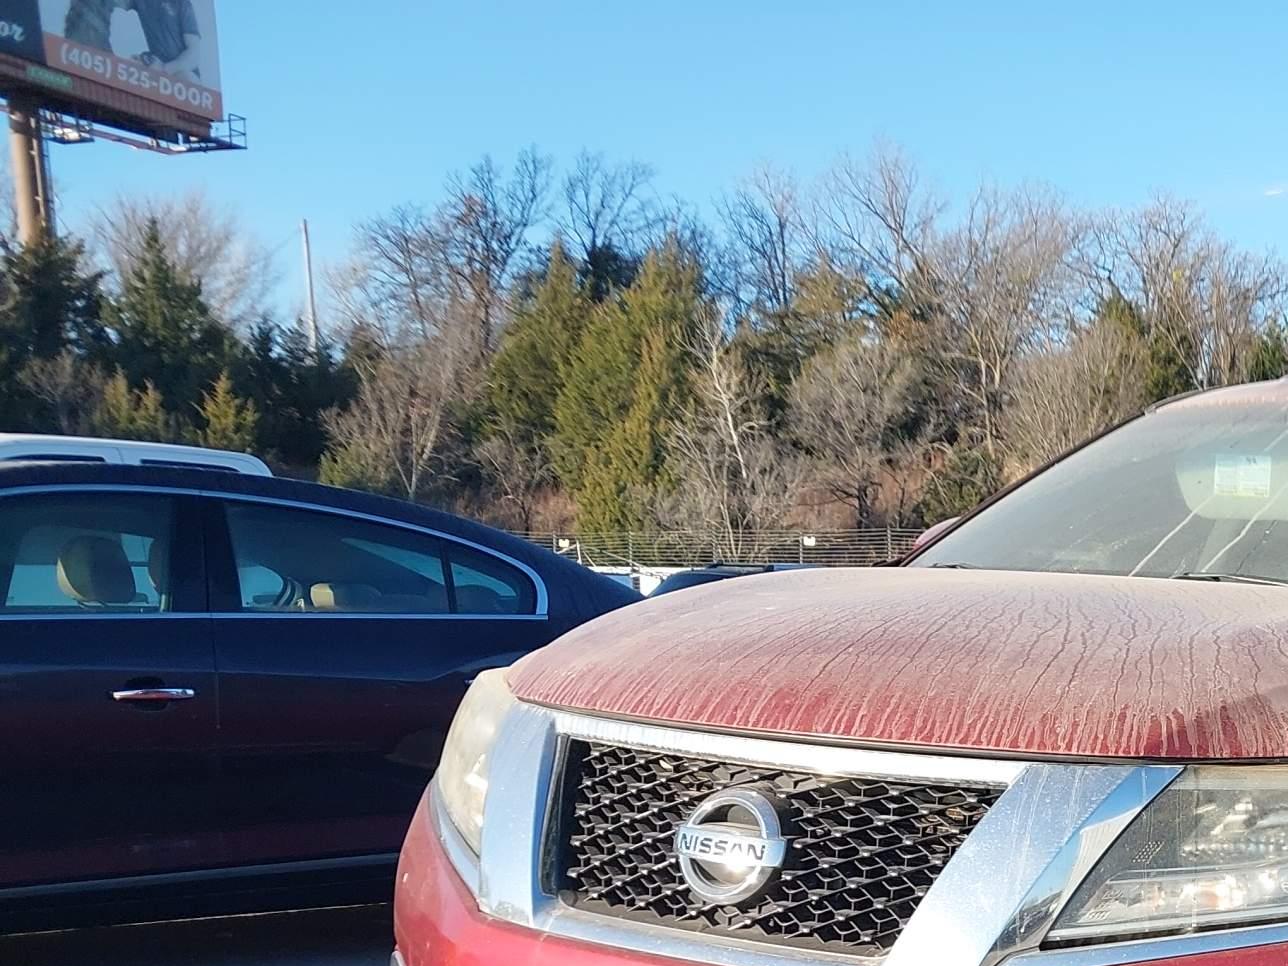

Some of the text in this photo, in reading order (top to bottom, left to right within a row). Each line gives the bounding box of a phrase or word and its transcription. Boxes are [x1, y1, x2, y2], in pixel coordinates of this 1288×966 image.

[60, 43, 112, 79] (405)
[117, 66, 213, 110] 525-DOOR
[679, 832, 766, 861] NISSAN
